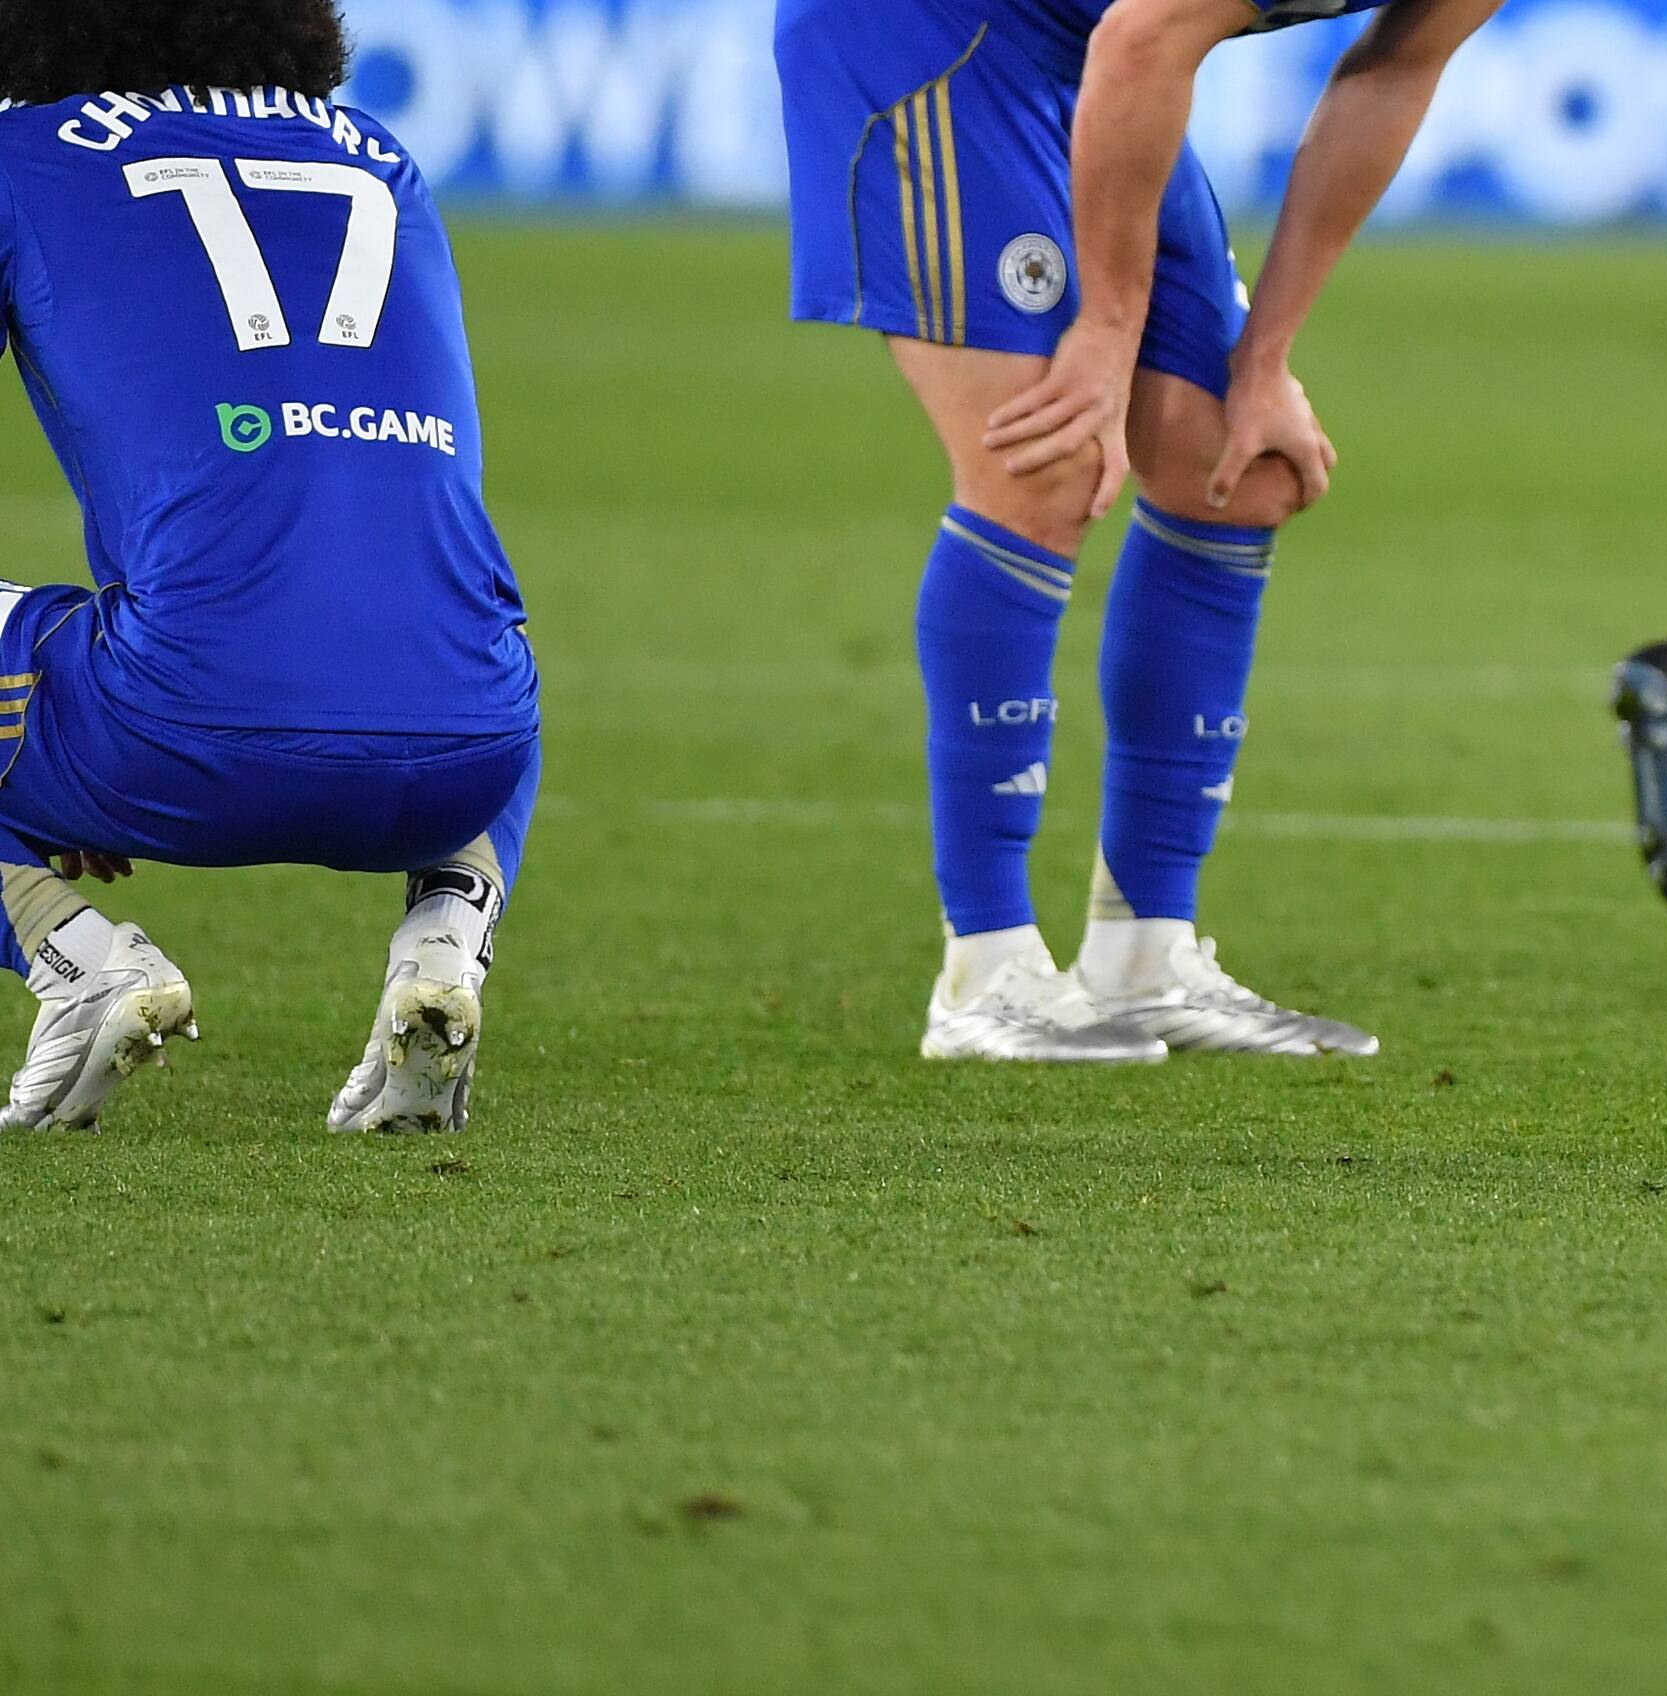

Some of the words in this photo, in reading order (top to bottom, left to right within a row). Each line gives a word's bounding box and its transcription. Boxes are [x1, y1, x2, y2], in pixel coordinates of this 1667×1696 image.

[122, 157, 398, 351] 17
[254, 332, 273, 341] EFL
[341, 331, 359, 340] EFL
[281, 403, 456, 456] BC.GAME
